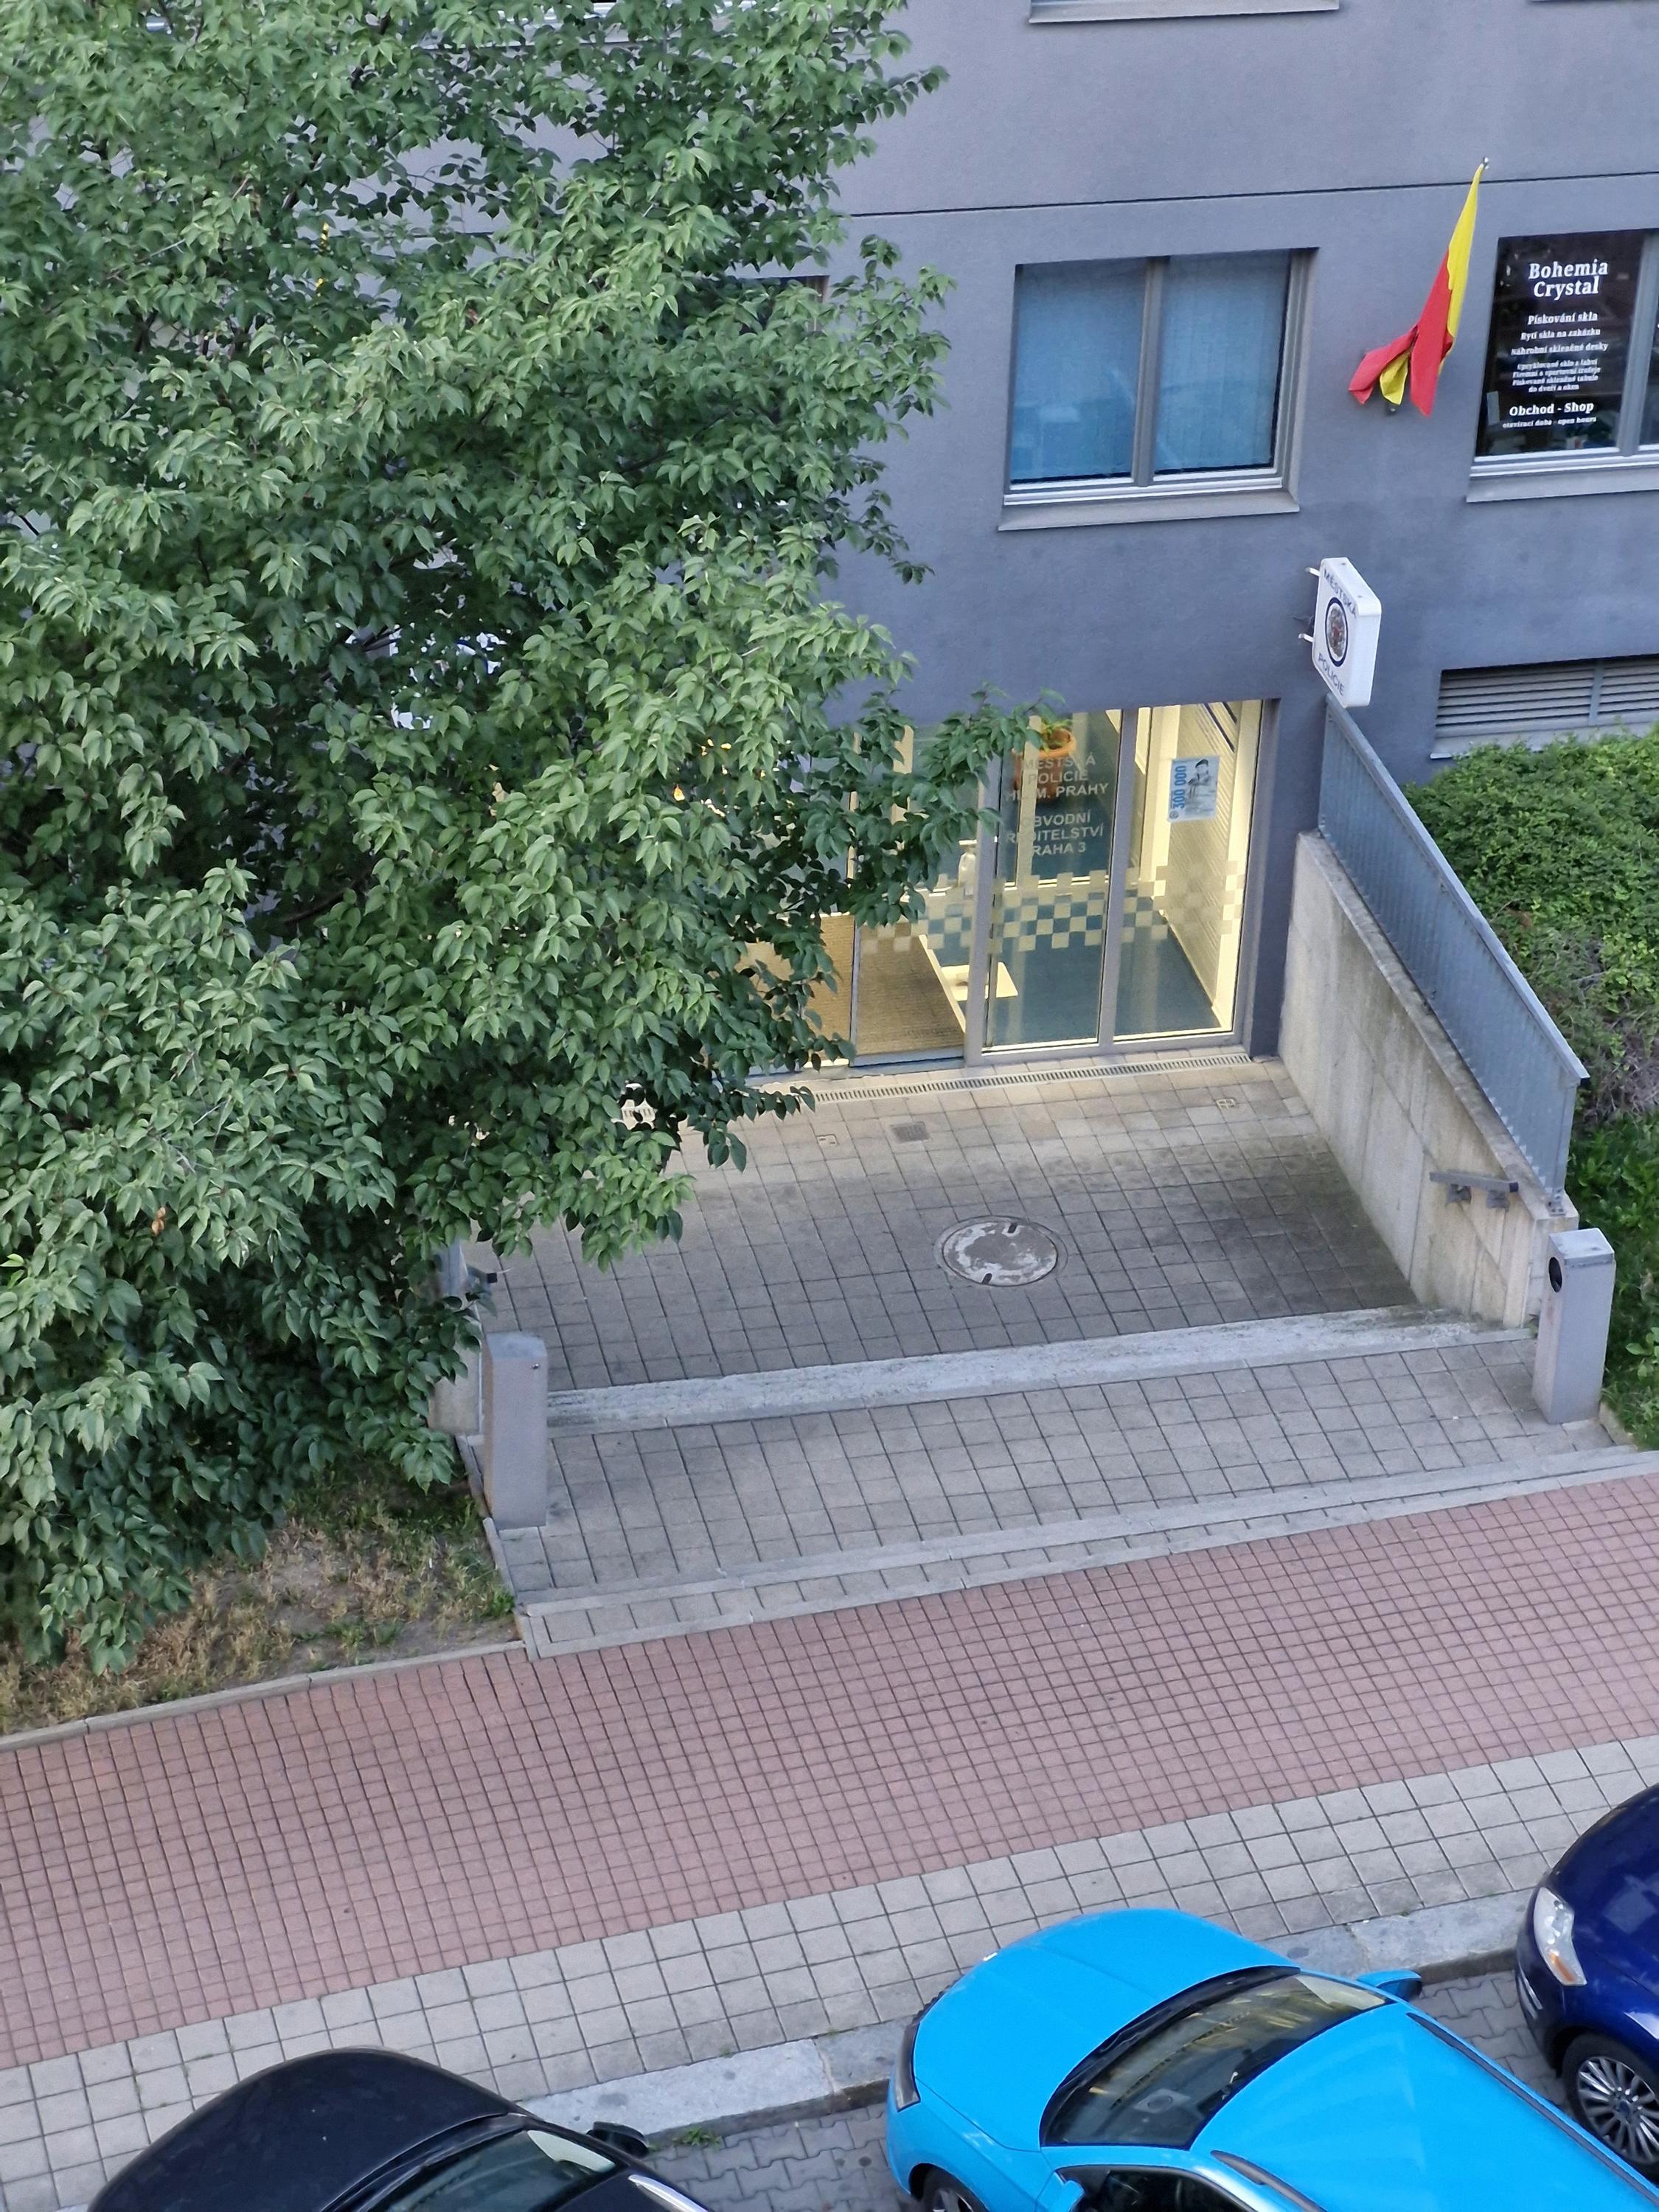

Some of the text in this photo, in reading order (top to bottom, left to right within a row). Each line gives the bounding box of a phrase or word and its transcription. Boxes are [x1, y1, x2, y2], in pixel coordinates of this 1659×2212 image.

[1528, 258, 1608, 279] Bohemia
[1534, 275, 1599, 301] Crystal
[1527, 311, 1598, 325] Pískování skla
[1509, 403, 1554, 417] Obchod
[1564, 402, 1594, 414] Shop
[1318, 653, 1345, 696] POLICIE
[1028, 769, 1090, 785] POLICIE
[1055, 783, 1109, 798] PRAHY
[1172, 765, 1187, 810] 300 000
[1078, 842, 1086, 853] 3
